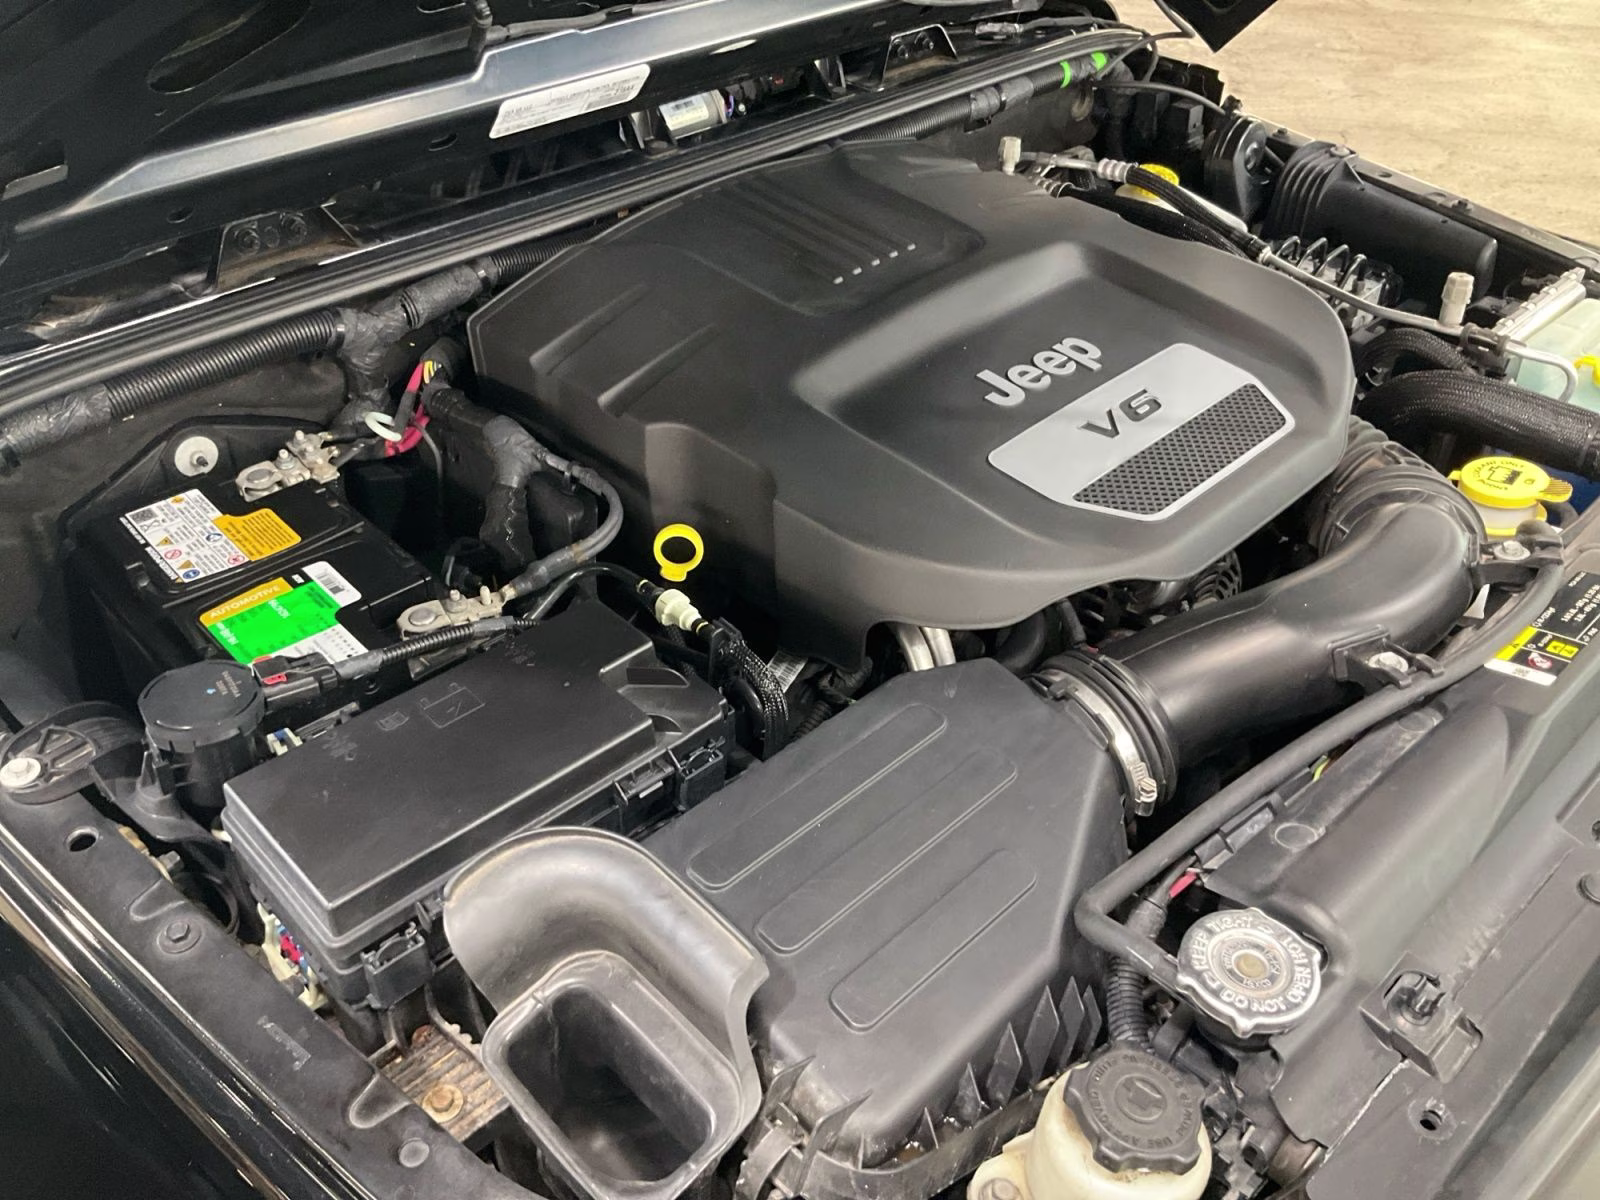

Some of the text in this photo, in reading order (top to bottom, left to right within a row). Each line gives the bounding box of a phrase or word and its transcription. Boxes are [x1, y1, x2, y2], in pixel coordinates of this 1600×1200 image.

[975, 337, 1102, 407] Jeep
[1077, 388, 1162, 439] V6
[209, 584, 281, 619] AUTOMOTIVE
[1191, 929, 1209, 971] KEEP
[1205, 916, 1253, 932] TIGHT
[1283, 936, 1309, 964] HOT
[1219, 985, 1249, 1008] DO
[1285, 965, 1312, 1004] OPEN
[1250, 995, 1287, 1013] NOT
[1146, 1136, 1173, 1149] USE
